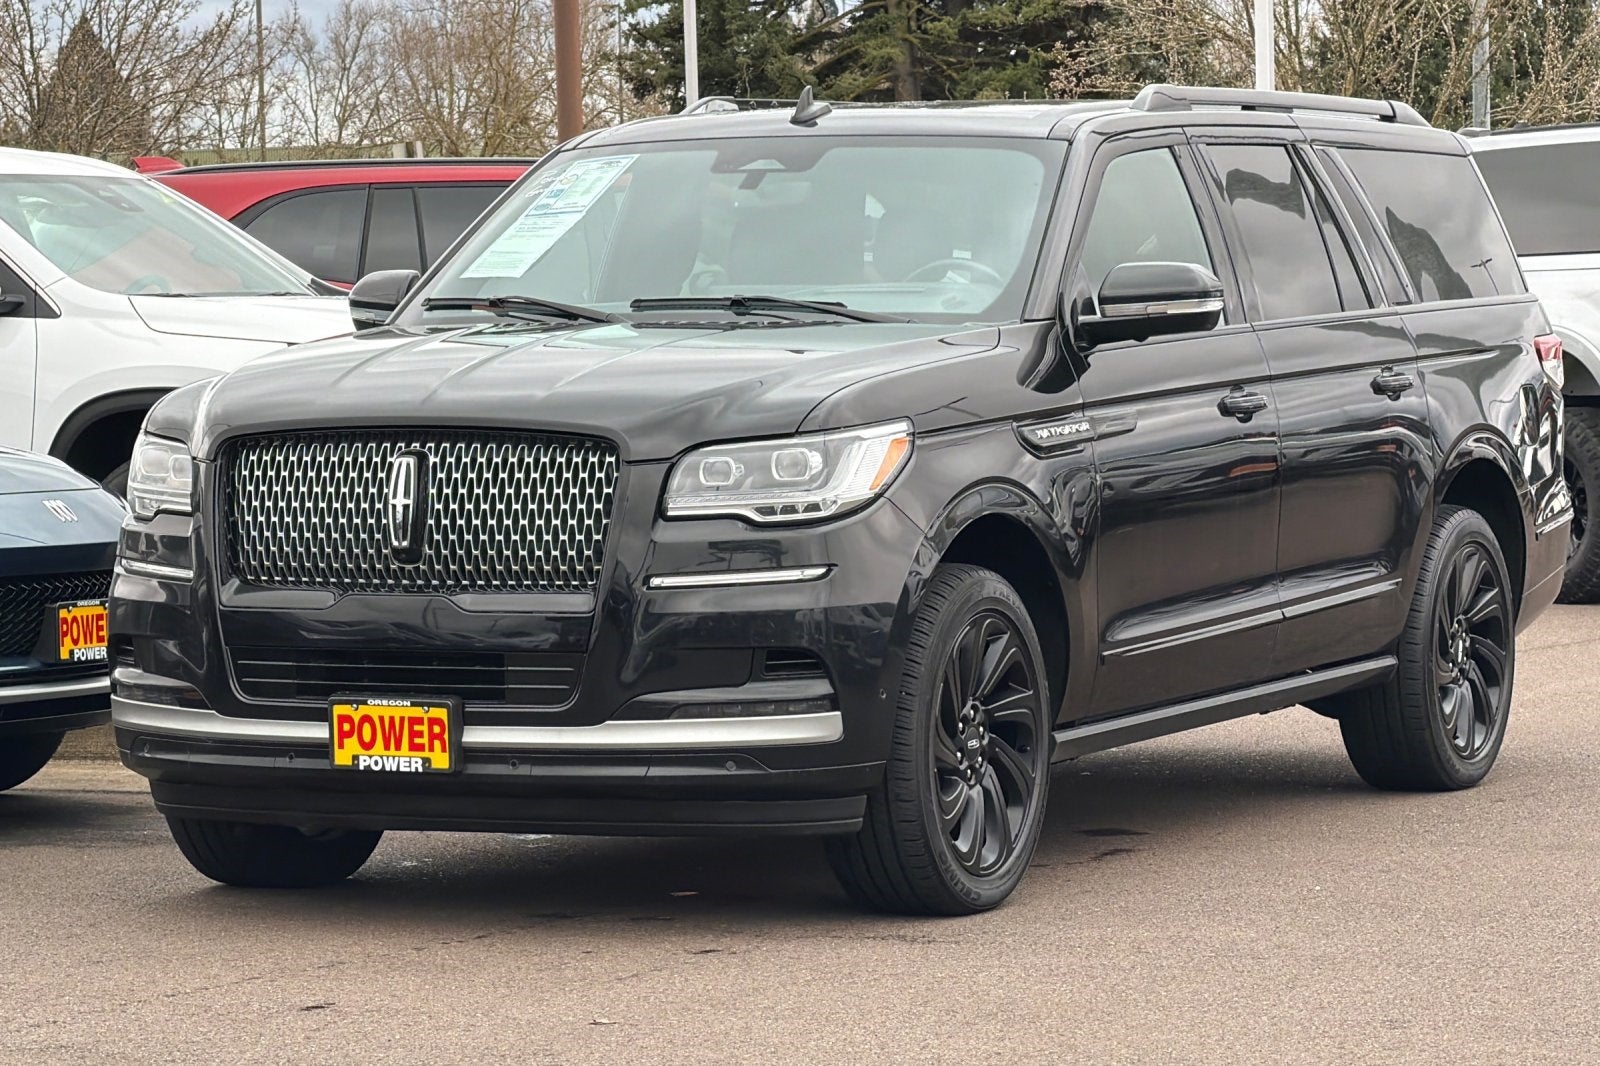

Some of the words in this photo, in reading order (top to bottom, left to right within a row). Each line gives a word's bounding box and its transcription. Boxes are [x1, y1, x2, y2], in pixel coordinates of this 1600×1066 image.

[60, 613, 108, 648] POWE
[74, 646, 108, 662] POWER
[366, 699, 411, 707] OREGON
[336, 713, 448, 754] POWER
[358, 755, 424, 773] POWER
